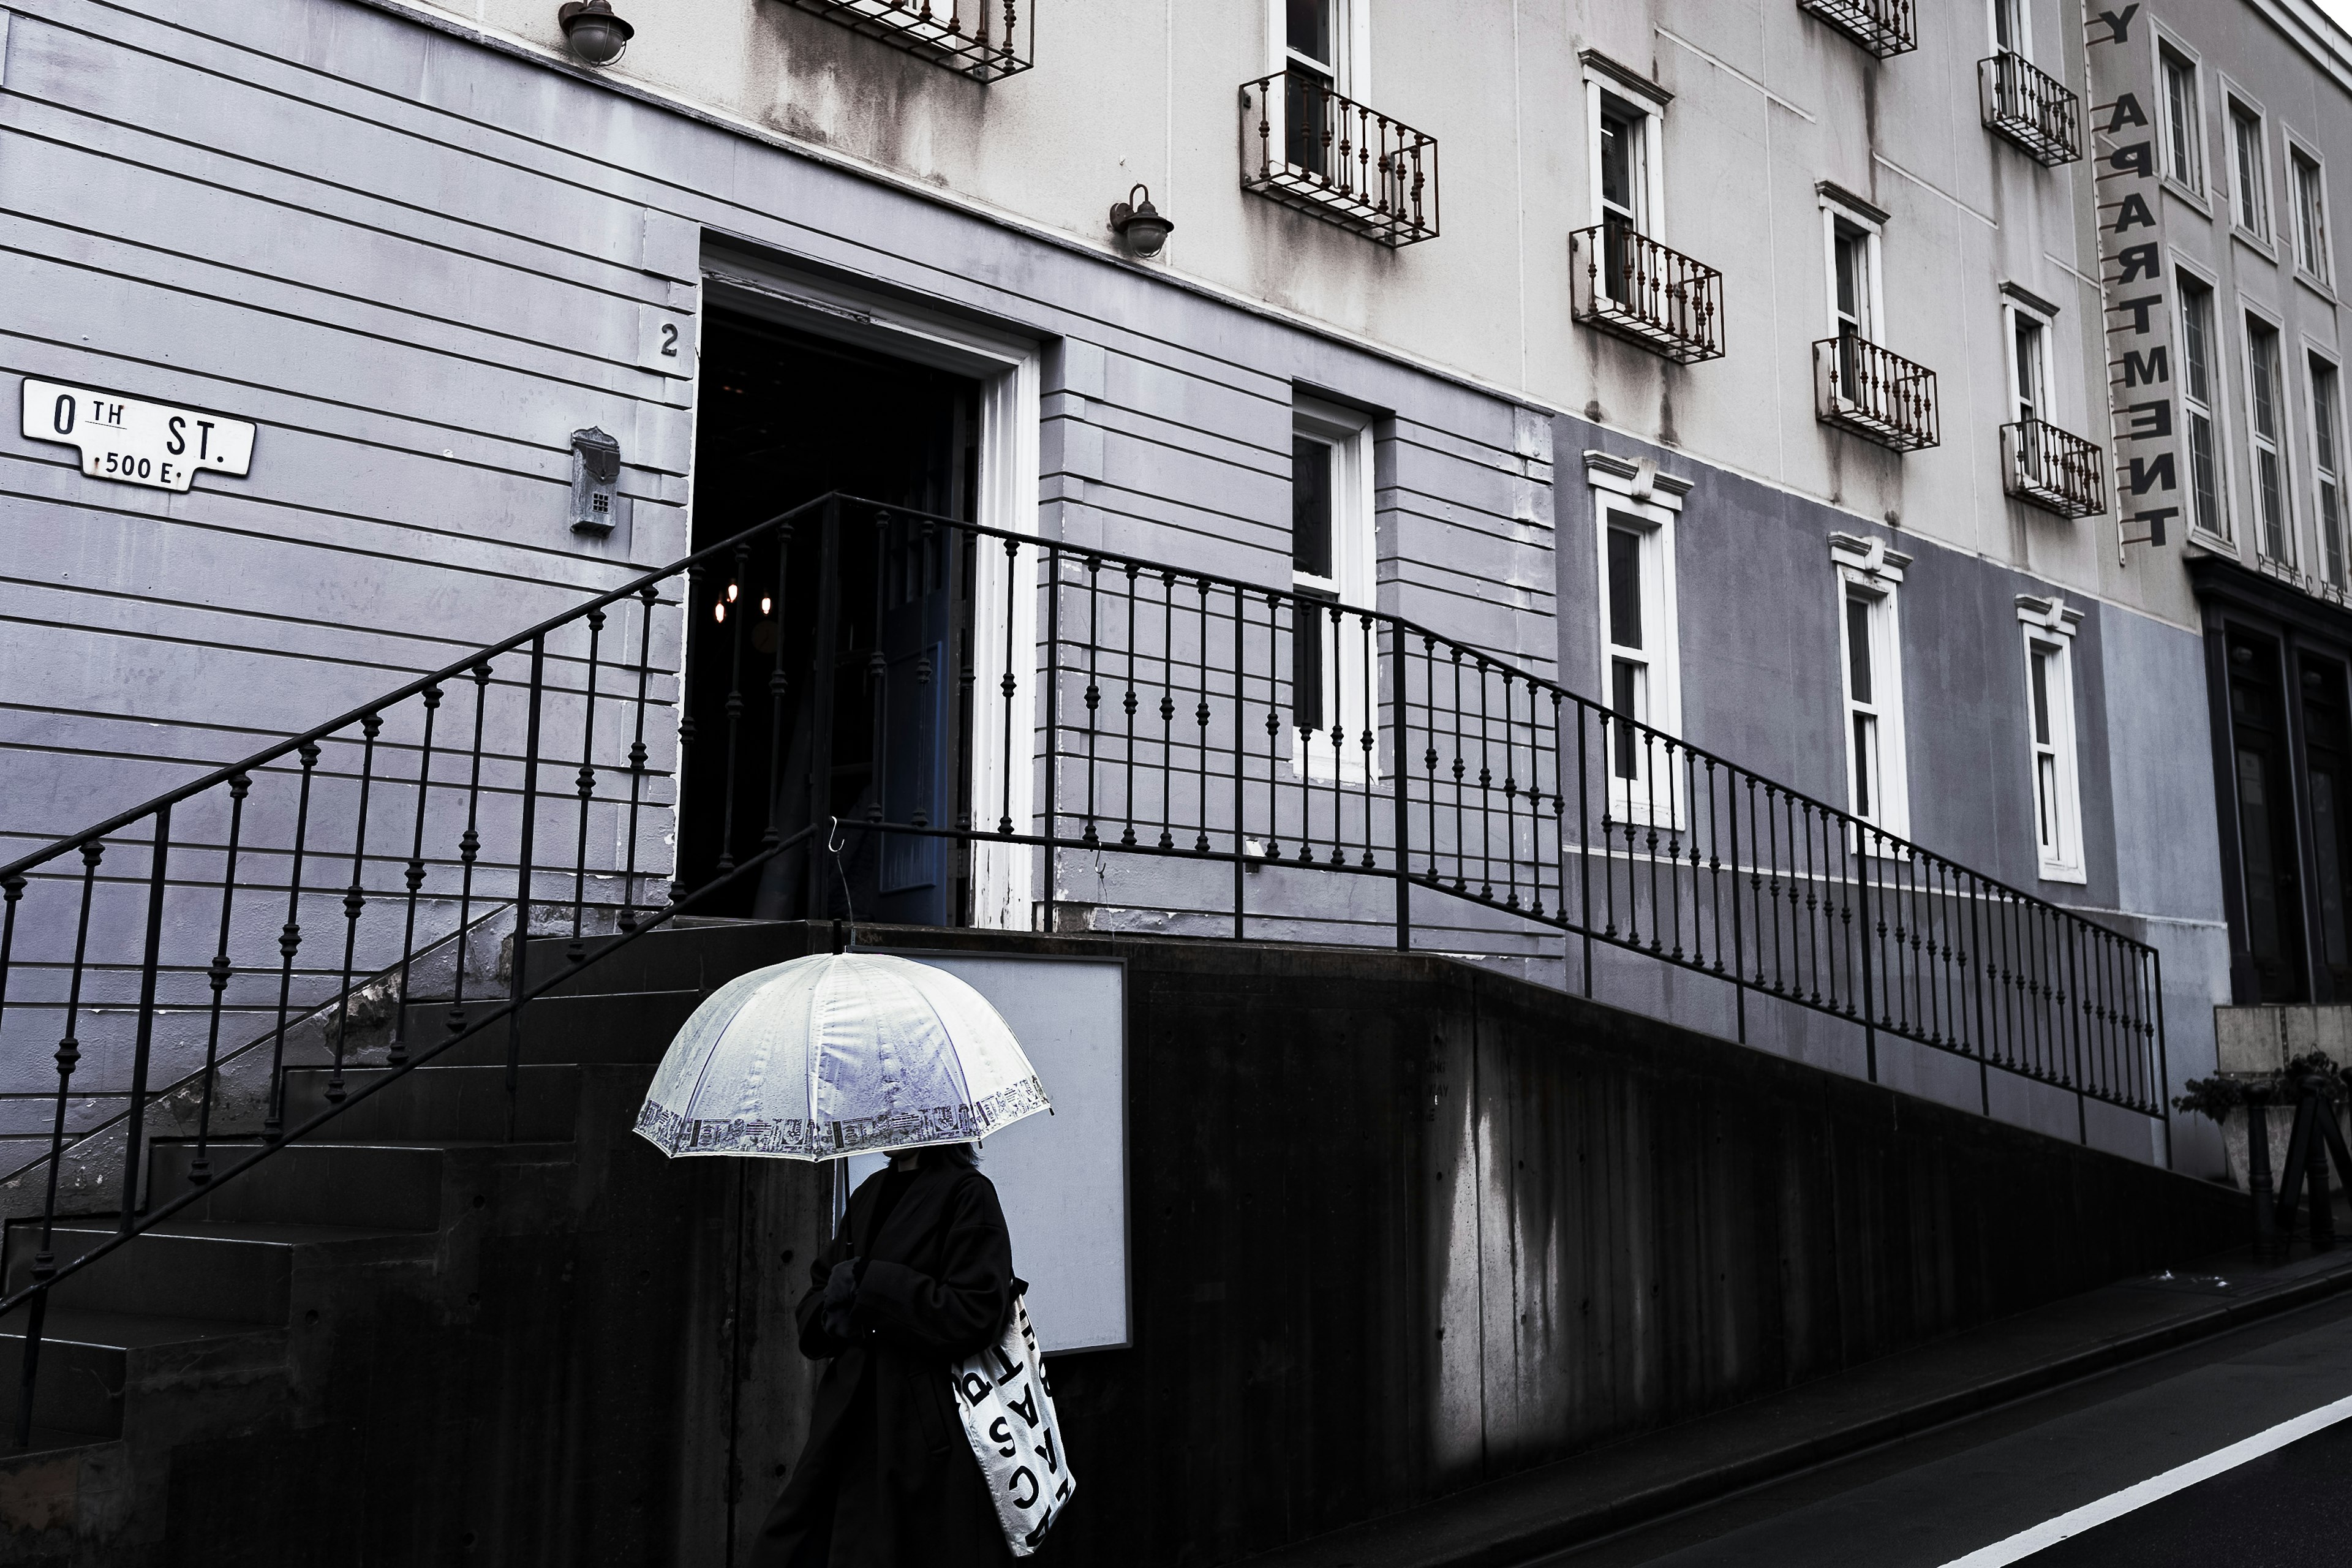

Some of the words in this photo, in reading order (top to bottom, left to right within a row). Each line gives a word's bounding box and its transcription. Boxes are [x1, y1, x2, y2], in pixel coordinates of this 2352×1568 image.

[661, 323, 679, 357] 2
[166, 416, 224, 463] ST.
[105, 452, 151, 478] 500
